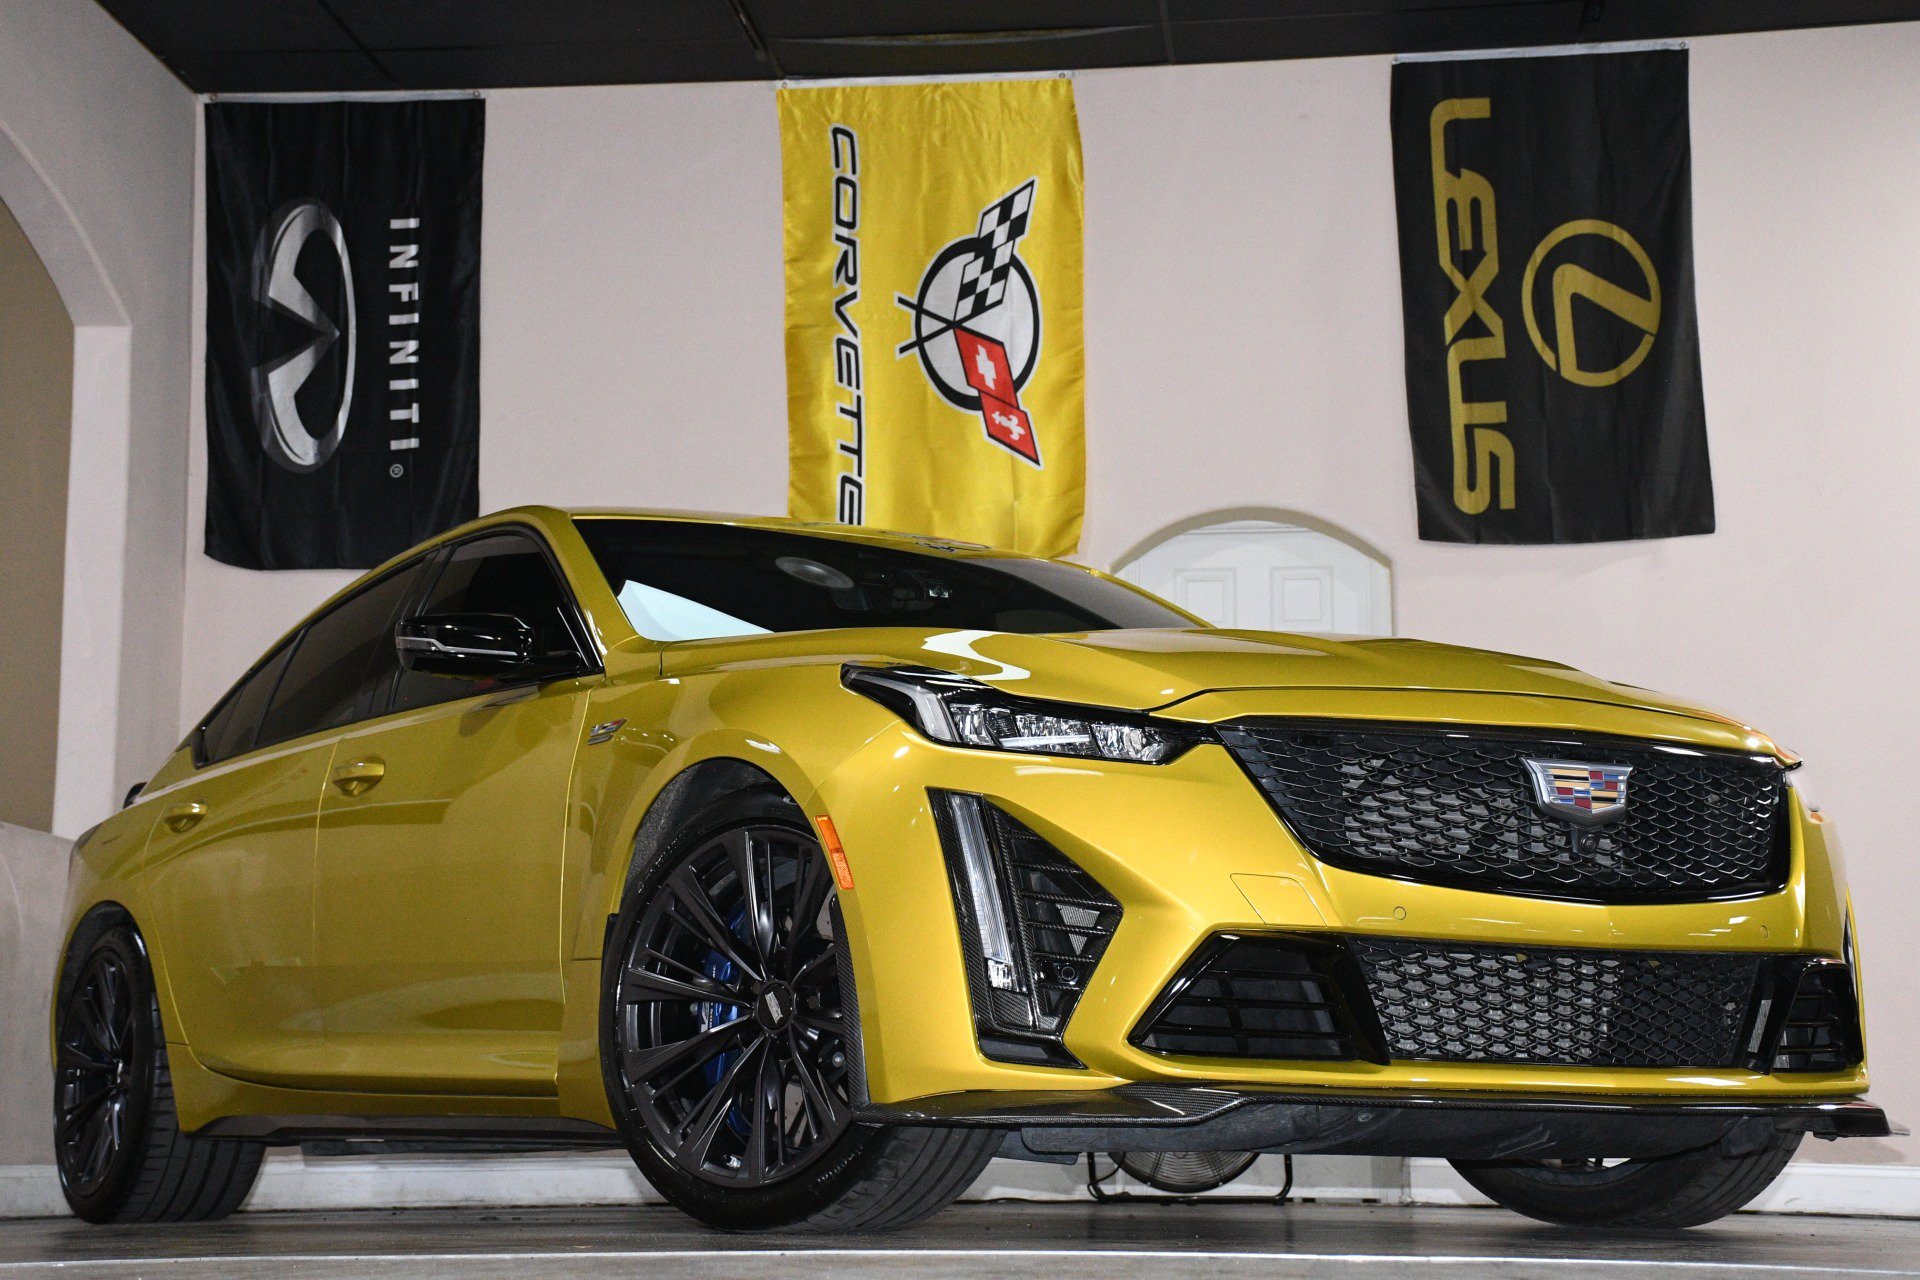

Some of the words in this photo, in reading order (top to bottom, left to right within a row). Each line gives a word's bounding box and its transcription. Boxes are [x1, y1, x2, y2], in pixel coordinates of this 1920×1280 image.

[389, 217, 420, 451] INFINITI
[831, 124, 865, 526] CORVETTE
[1430, 97, 1515, 515] LEXUS
